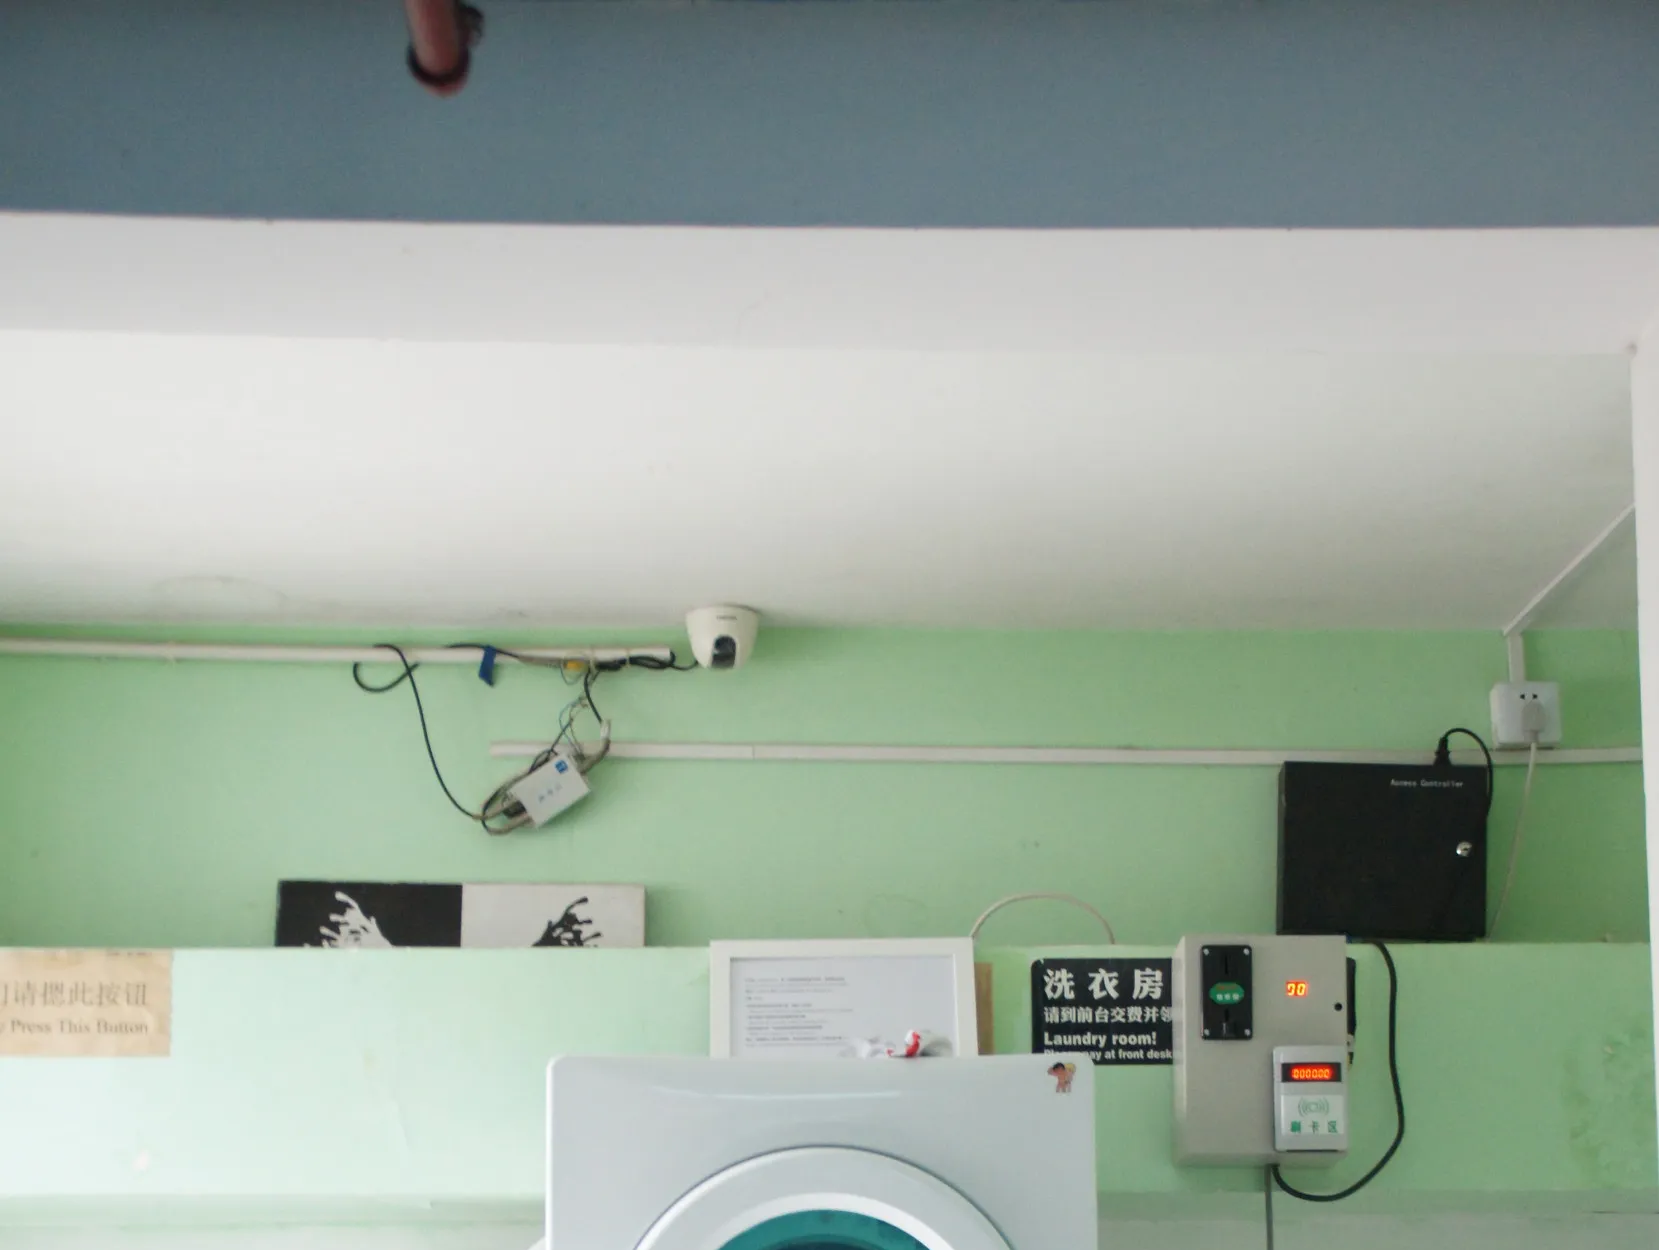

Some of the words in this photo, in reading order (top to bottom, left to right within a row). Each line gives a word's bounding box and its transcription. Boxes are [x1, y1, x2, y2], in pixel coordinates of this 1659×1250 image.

[1390, 778, 1417, 787] Access
[1420, 778, 1464, 788] Controller
[1043, 968, 1164, 1000] 洗衣房
[1286, 982, 1306, 996] 00
[10, 1019, 52, 1034] Press
[60, 1019, 90, 1034] This
[97, 1019, 148, 1035] Button
[1044, 1031, 1107, 1048] Laundry
[1112, 1031, 1157, 1046] room!
[1105, 1049, 1116, 1059] at
[1118, 1049, 1144, 1059] front
[1291, 1068, 1330, 1079] 000000
